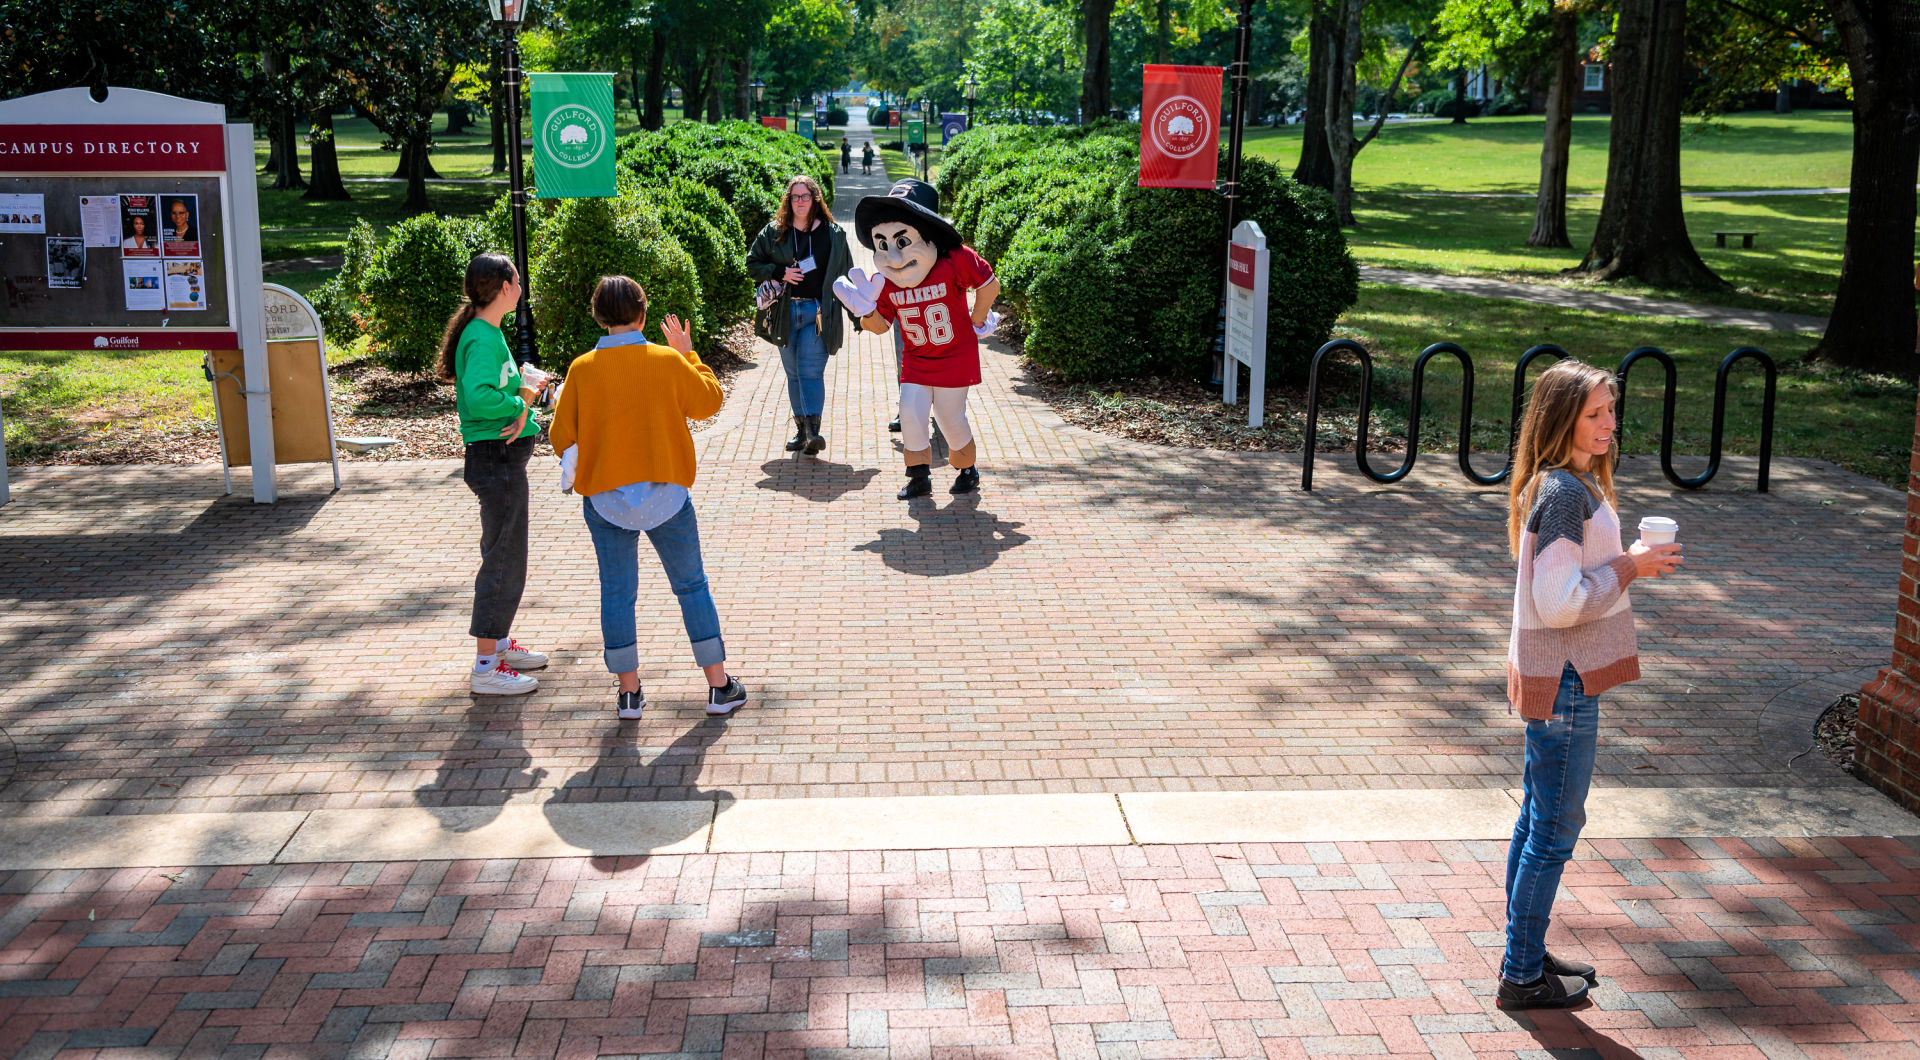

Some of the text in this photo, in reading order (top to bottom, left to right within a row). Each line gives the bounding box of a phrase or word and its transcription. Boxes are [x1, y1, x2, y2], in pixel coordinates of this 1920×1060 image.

[1160, 102, 1203, 123] GUILFORD
[551, 111, 597, 131] GUILFORD
[0, 142, 200, 154] CAMPUS DIRECTORY
[1165, 142, 1196, 152] COLLEGE
[559, 151, 591, 161] COLLEGE
[889, 282, 947, 306] QUAKERS
[897, 302, 955, 347] 58
[110, 336, 139, 345] Guilford
